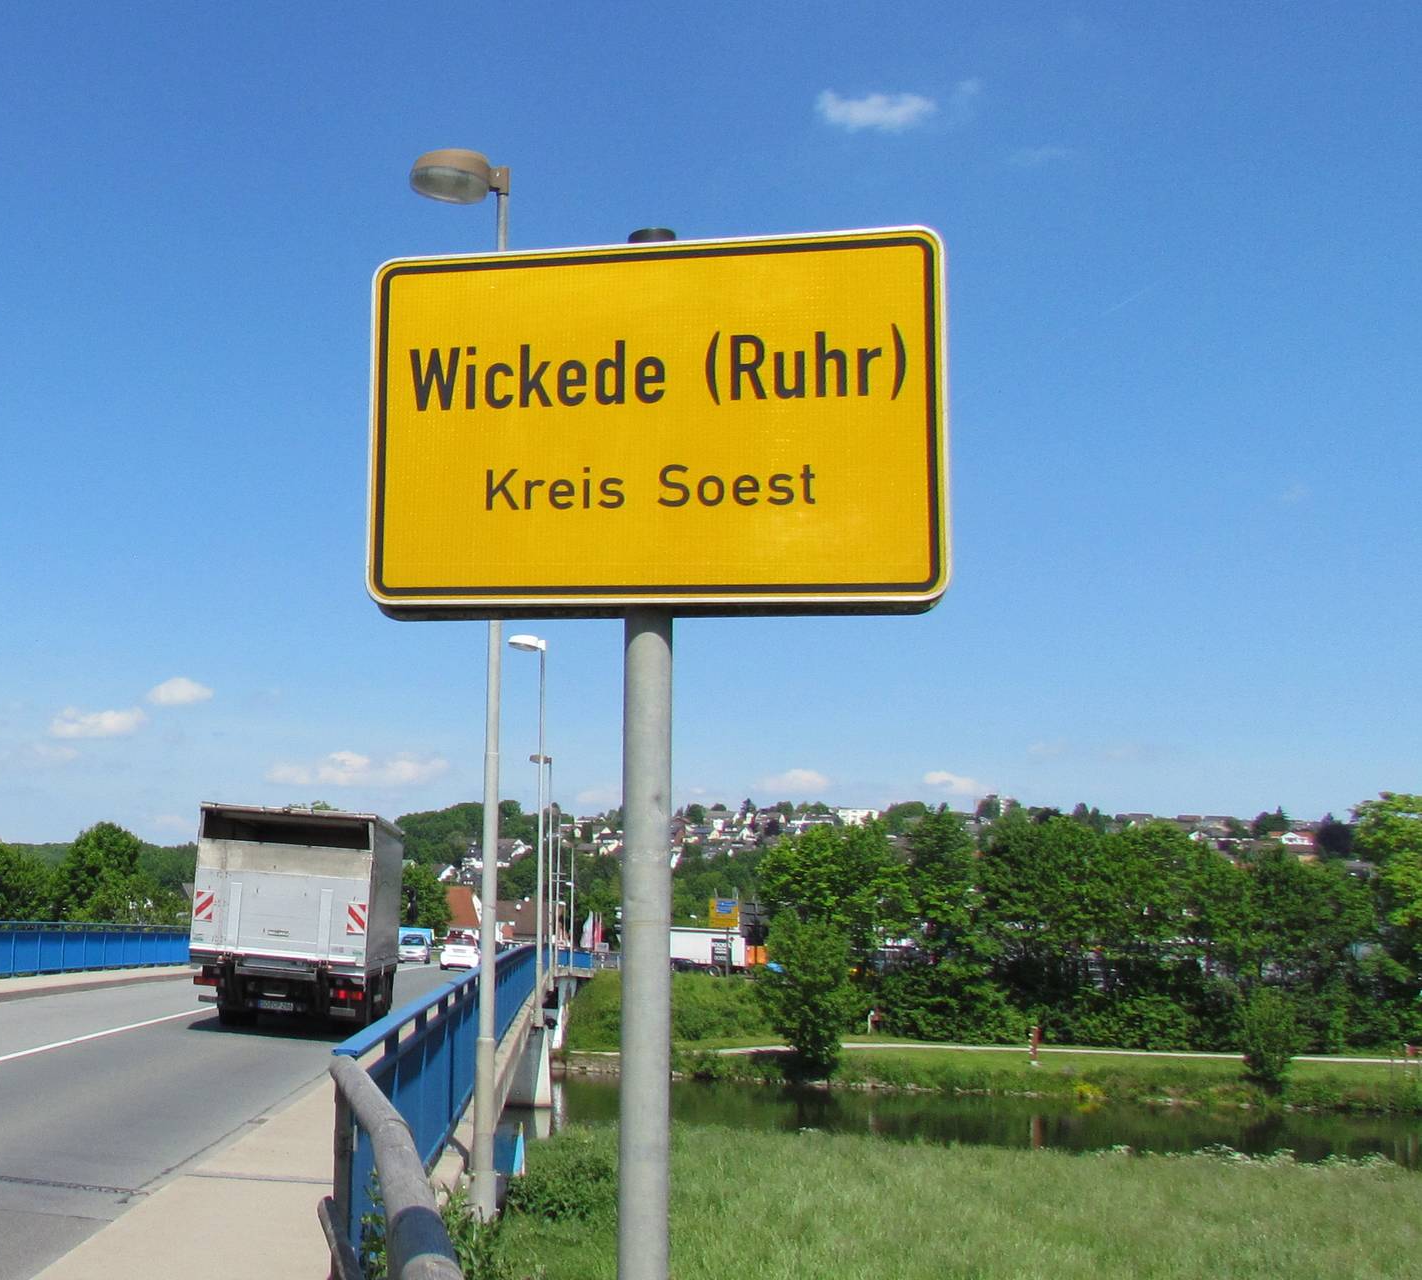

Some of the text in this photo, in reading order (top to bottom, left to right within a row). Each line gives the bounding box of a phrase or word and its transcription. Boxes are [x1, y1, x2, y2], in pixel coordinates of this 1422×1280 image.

[410, 323, 907, 411] Wickede (Ruhr)
[486, 464, 816, 511] Kreis Soest
